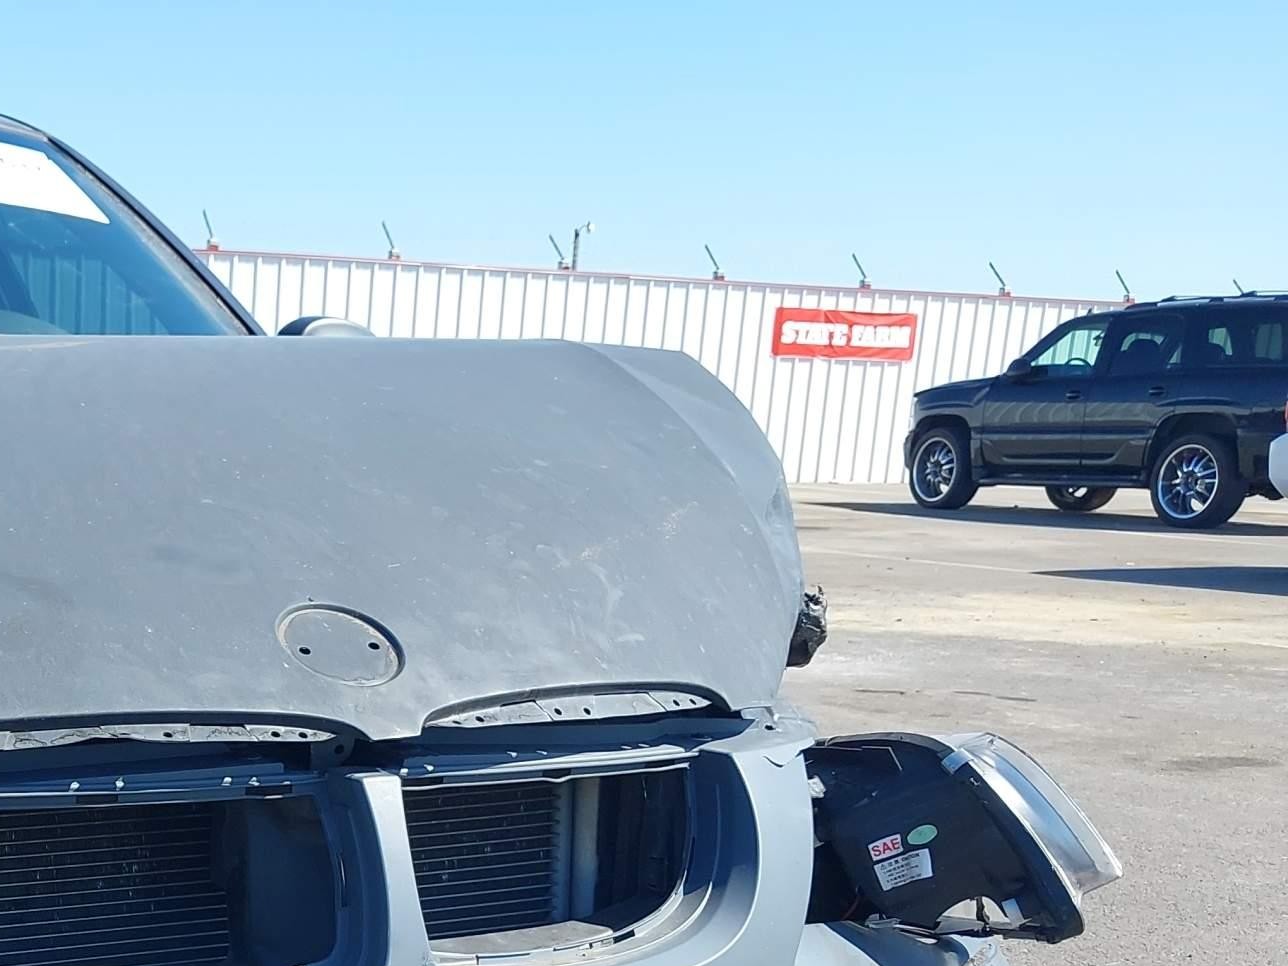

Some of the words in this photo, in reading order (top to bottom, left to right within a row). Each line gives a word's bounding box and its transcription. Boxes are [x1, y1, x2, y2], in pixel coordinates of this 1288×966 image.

[781, 321, 848, 345] STATE
[850, 325, 911, 348] FARM
[872, 838, 900, 857] SAE
